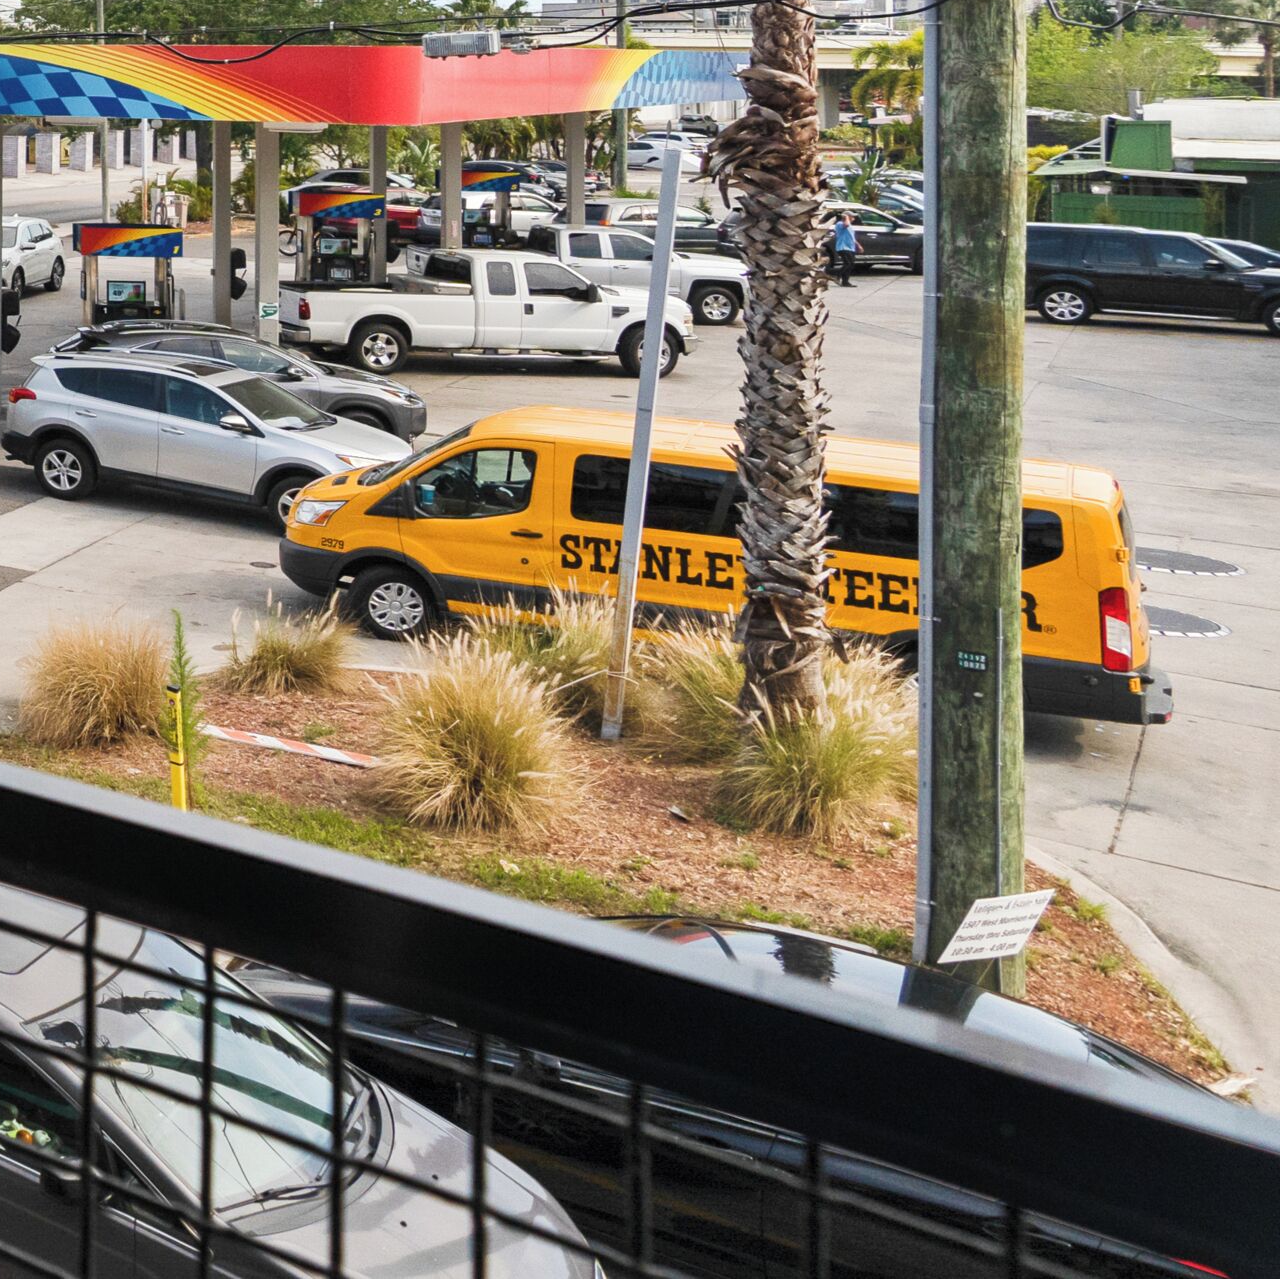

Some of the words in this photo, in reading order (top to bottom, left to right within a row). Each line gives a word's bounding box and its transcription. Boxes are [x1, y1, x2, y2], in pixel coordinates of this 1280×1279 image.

[373, 208, 382, 217] 3
[321, 536, 345, 549] 2979
[559, 533, 746, 590] STNLE
